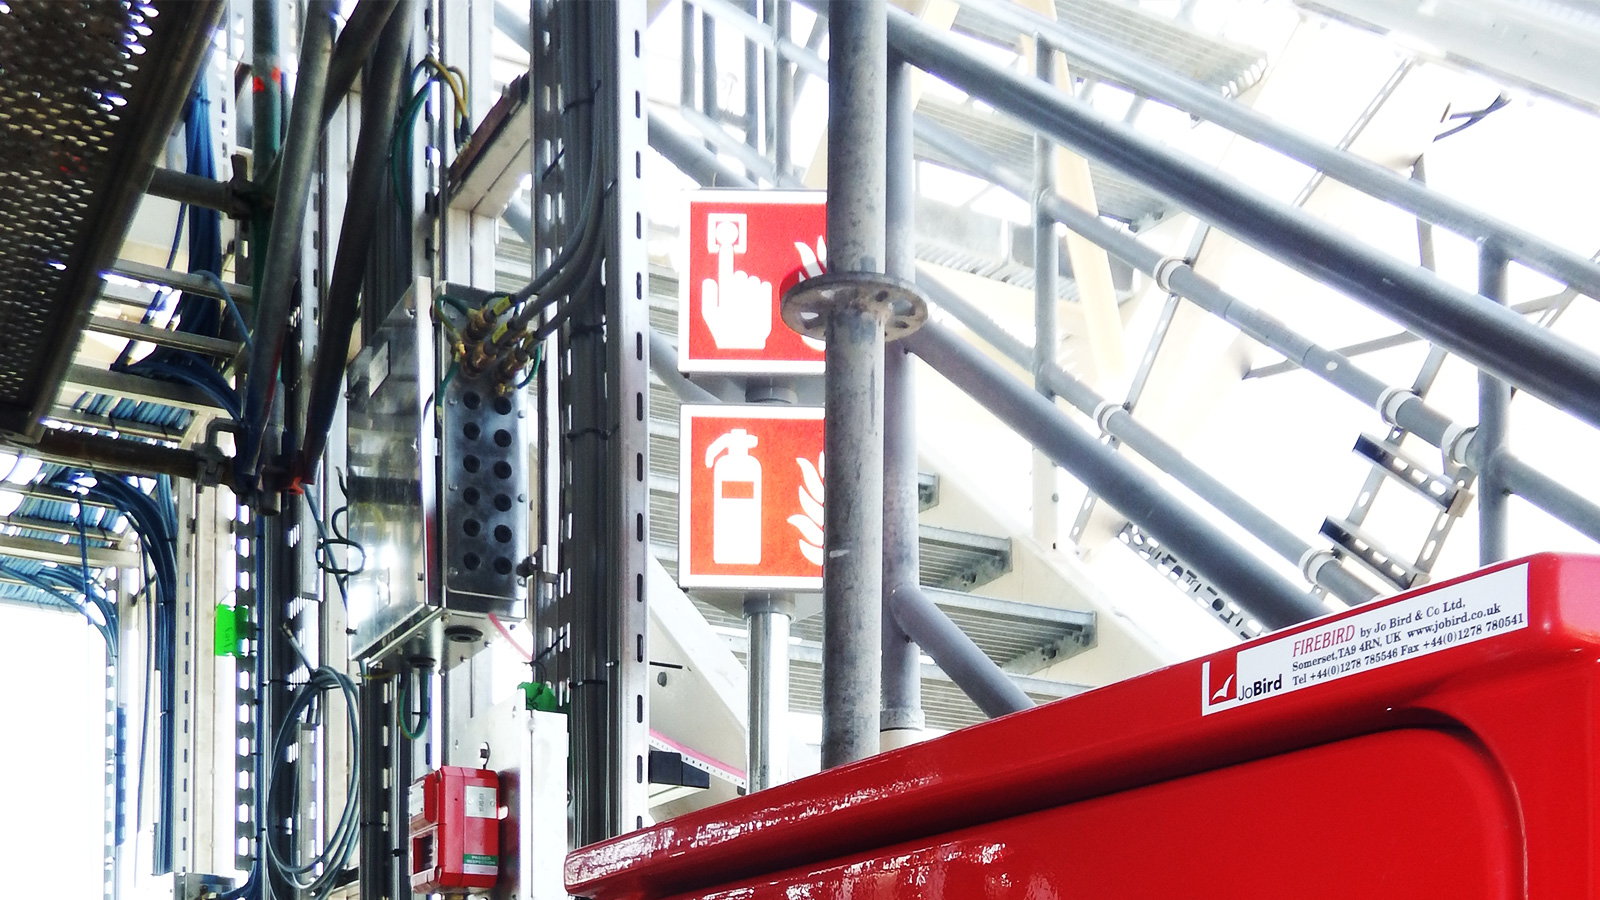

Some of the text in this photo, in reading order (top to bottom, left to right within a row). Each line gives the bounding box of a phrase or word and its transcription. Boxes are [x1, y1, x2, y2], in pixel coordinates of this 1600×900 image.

[1292, 624, 1356, 657] FIREBIRD
[1360, 627, 1373, 638] by
[1373, 622, 1386, 634] Jo
[1389, 613, 1412, 629] Bird
[1414, 609, 1423, 621] &
[1426, 606, 1440, 618] Co
[1385, 631, 1402, 645] UK
[1407, 603, 1501, 638] www.jobird.co.uk
[1292, 613, 1524, 686] Tel +44(0)1278 785546 Fax +44(0)1278 780541
[1238, 673, 1282, 701] JoBird
